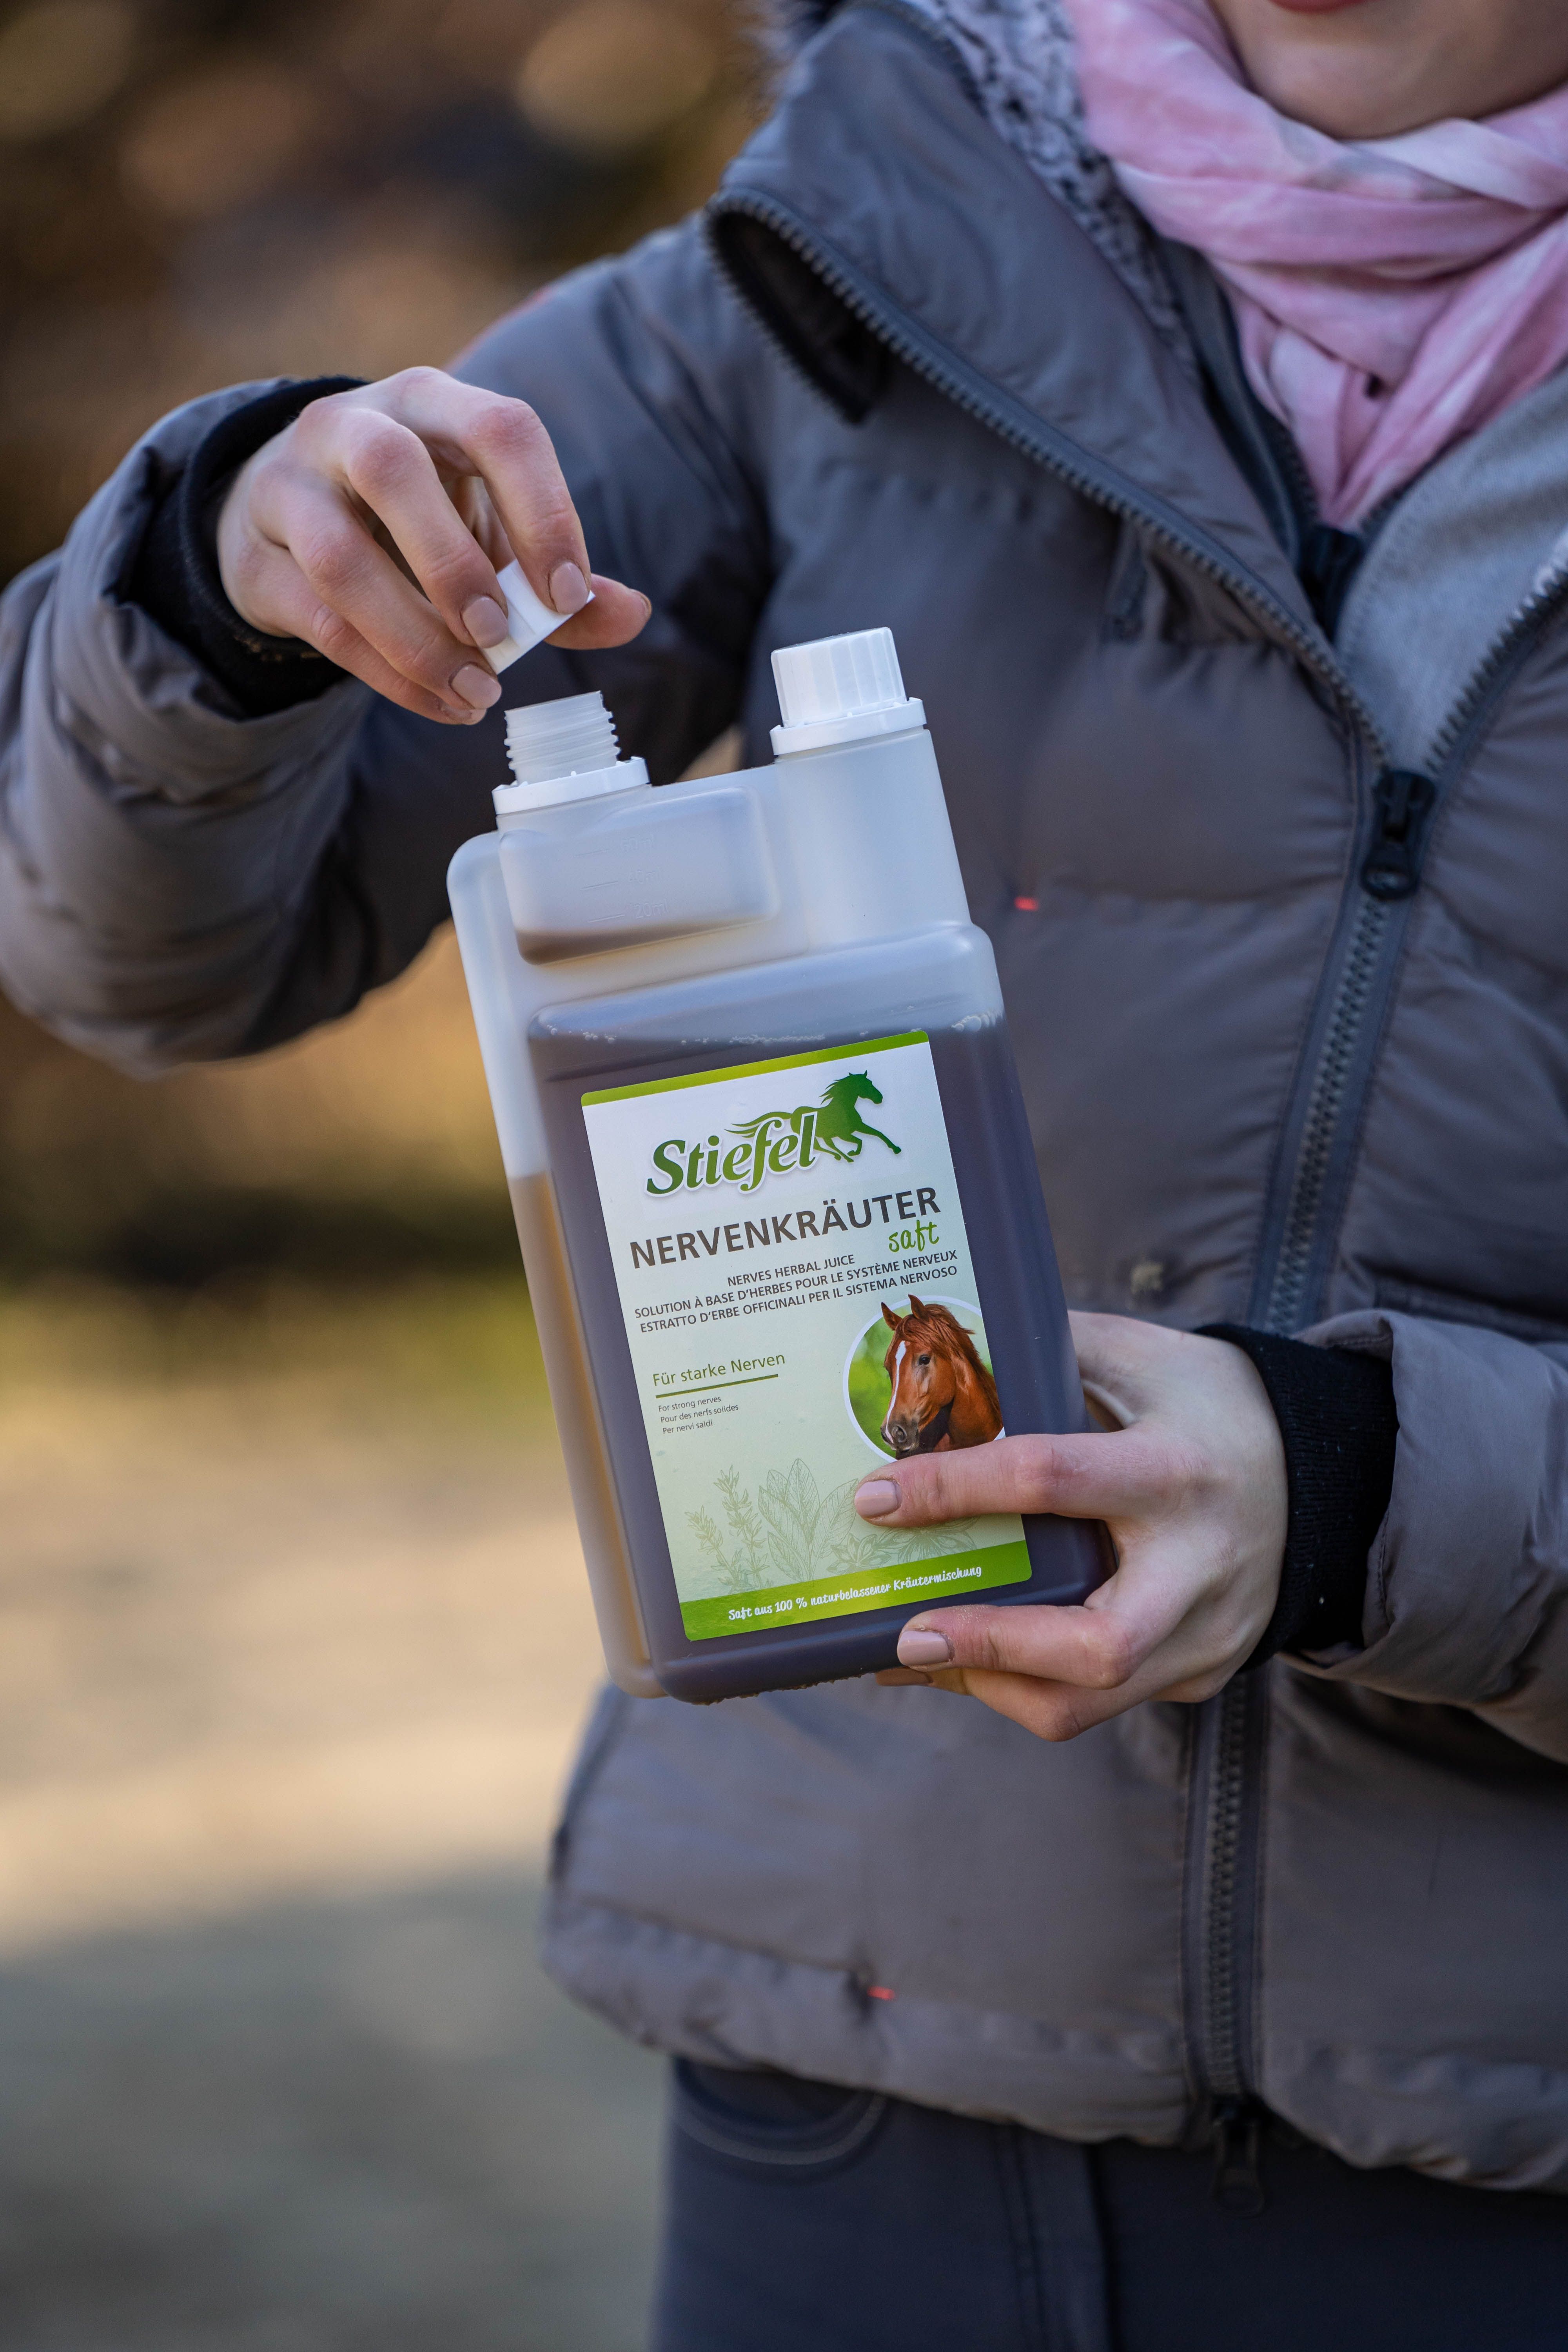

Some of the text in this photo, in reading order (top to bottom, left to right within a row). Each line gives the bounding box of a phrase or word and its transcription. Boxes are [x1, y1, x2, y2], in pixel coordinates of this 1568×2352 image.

[633, 898, 669, 919] 20ml
[647, 1114, 816, 1194] Stiefel
[630, 1187, 941, 1269] NERVENKRÄUTER
[889, 1220, 939, 1252] saft
[635, 1300, 691, 1318] SOLUTION
[695, 1296, 703, 1308] À
[706, 1292, 735, 1306] BASE
[795, 1275, 828, 1289] POUR
[831, 1272, 844, 1283] LE
[847, 1261, 900, 1280] SYSTÈME
[903, 1250, 958, 1269] NERVEUX
[728, 1254, 855, 1287] NERVES HERBAL JUICE
[640, 1315, 696, 1332] ESTRATTO
[743, 1294, 805, 1314] OFFICINALI
[809, 1290, 830, 1303] PER
[833, 1288, 843, 1298] IL
[846, 1278, 897, 1296] SISTEMA
[900, 1266, 957, 1285] NERVOSO
[653, 1355, 785, 1386] Für starke Nerven
[672, 1401, 695, 1410] strong
[697, 1397, 721, 1405] nerves
[694, 1408, 712, 1417] nerfs
[714, 1405, 739, 1414] solides
[677, 1423, 694, 1432] nervi
[696, 1419, 713, 1428] saldi
[728, 1567, 981, 1620] Saft aus 100 % naturbelassener Kräutermischung
